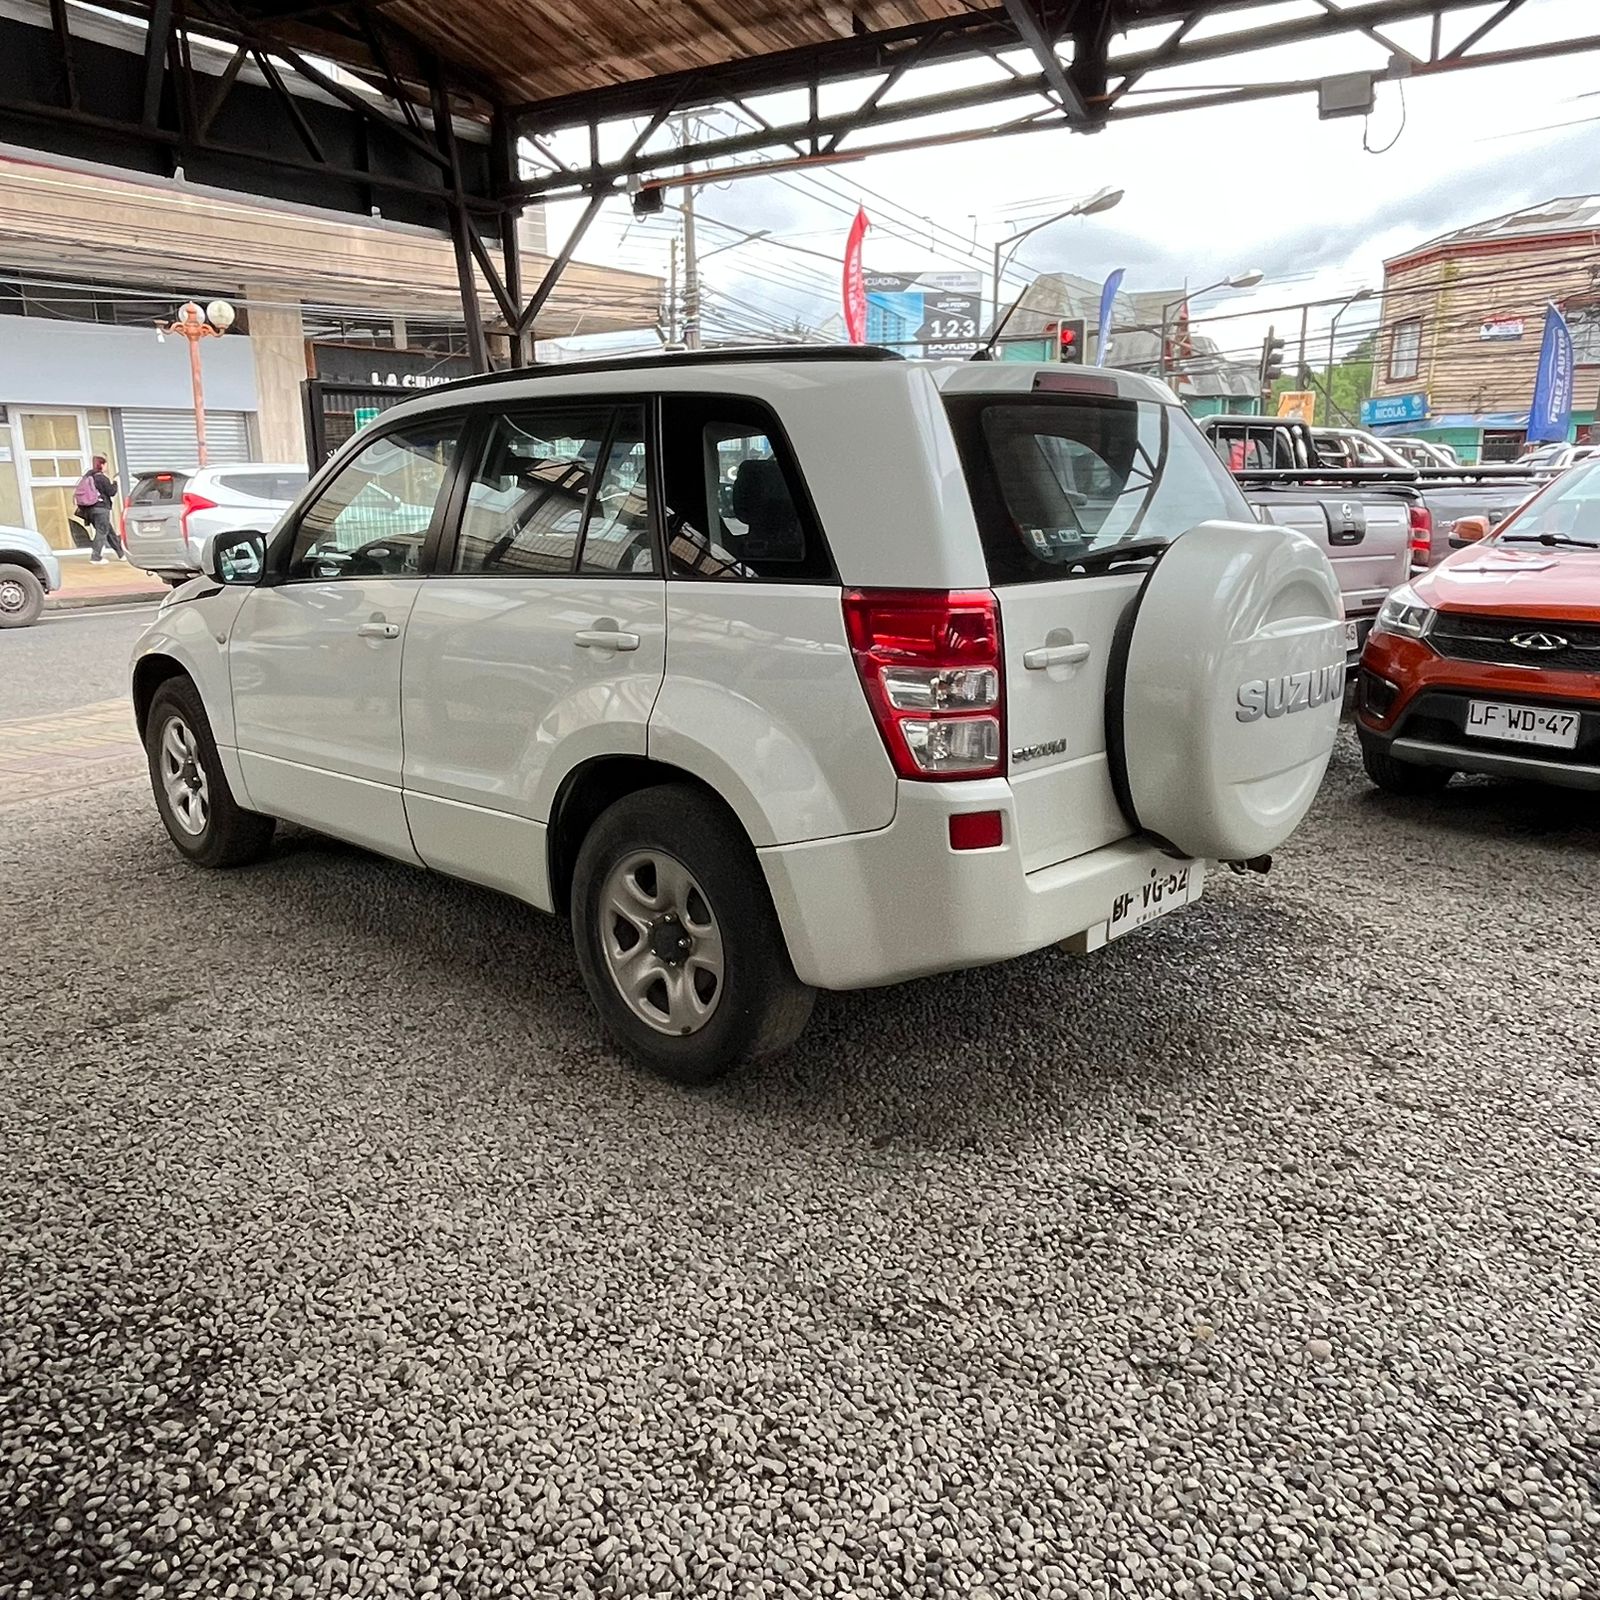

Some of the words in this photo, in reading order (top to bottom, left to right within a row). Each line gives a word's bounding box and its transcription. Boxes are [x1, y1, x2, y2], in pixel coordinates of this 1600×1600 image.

[1550, 378, 1564, 422] PEREZ
[1557, 329, 1565, 375] AUTOS
[1375, 406, 1407, 419] NICOLAS
[1012, 738, 1067, 764] SUZUKI
